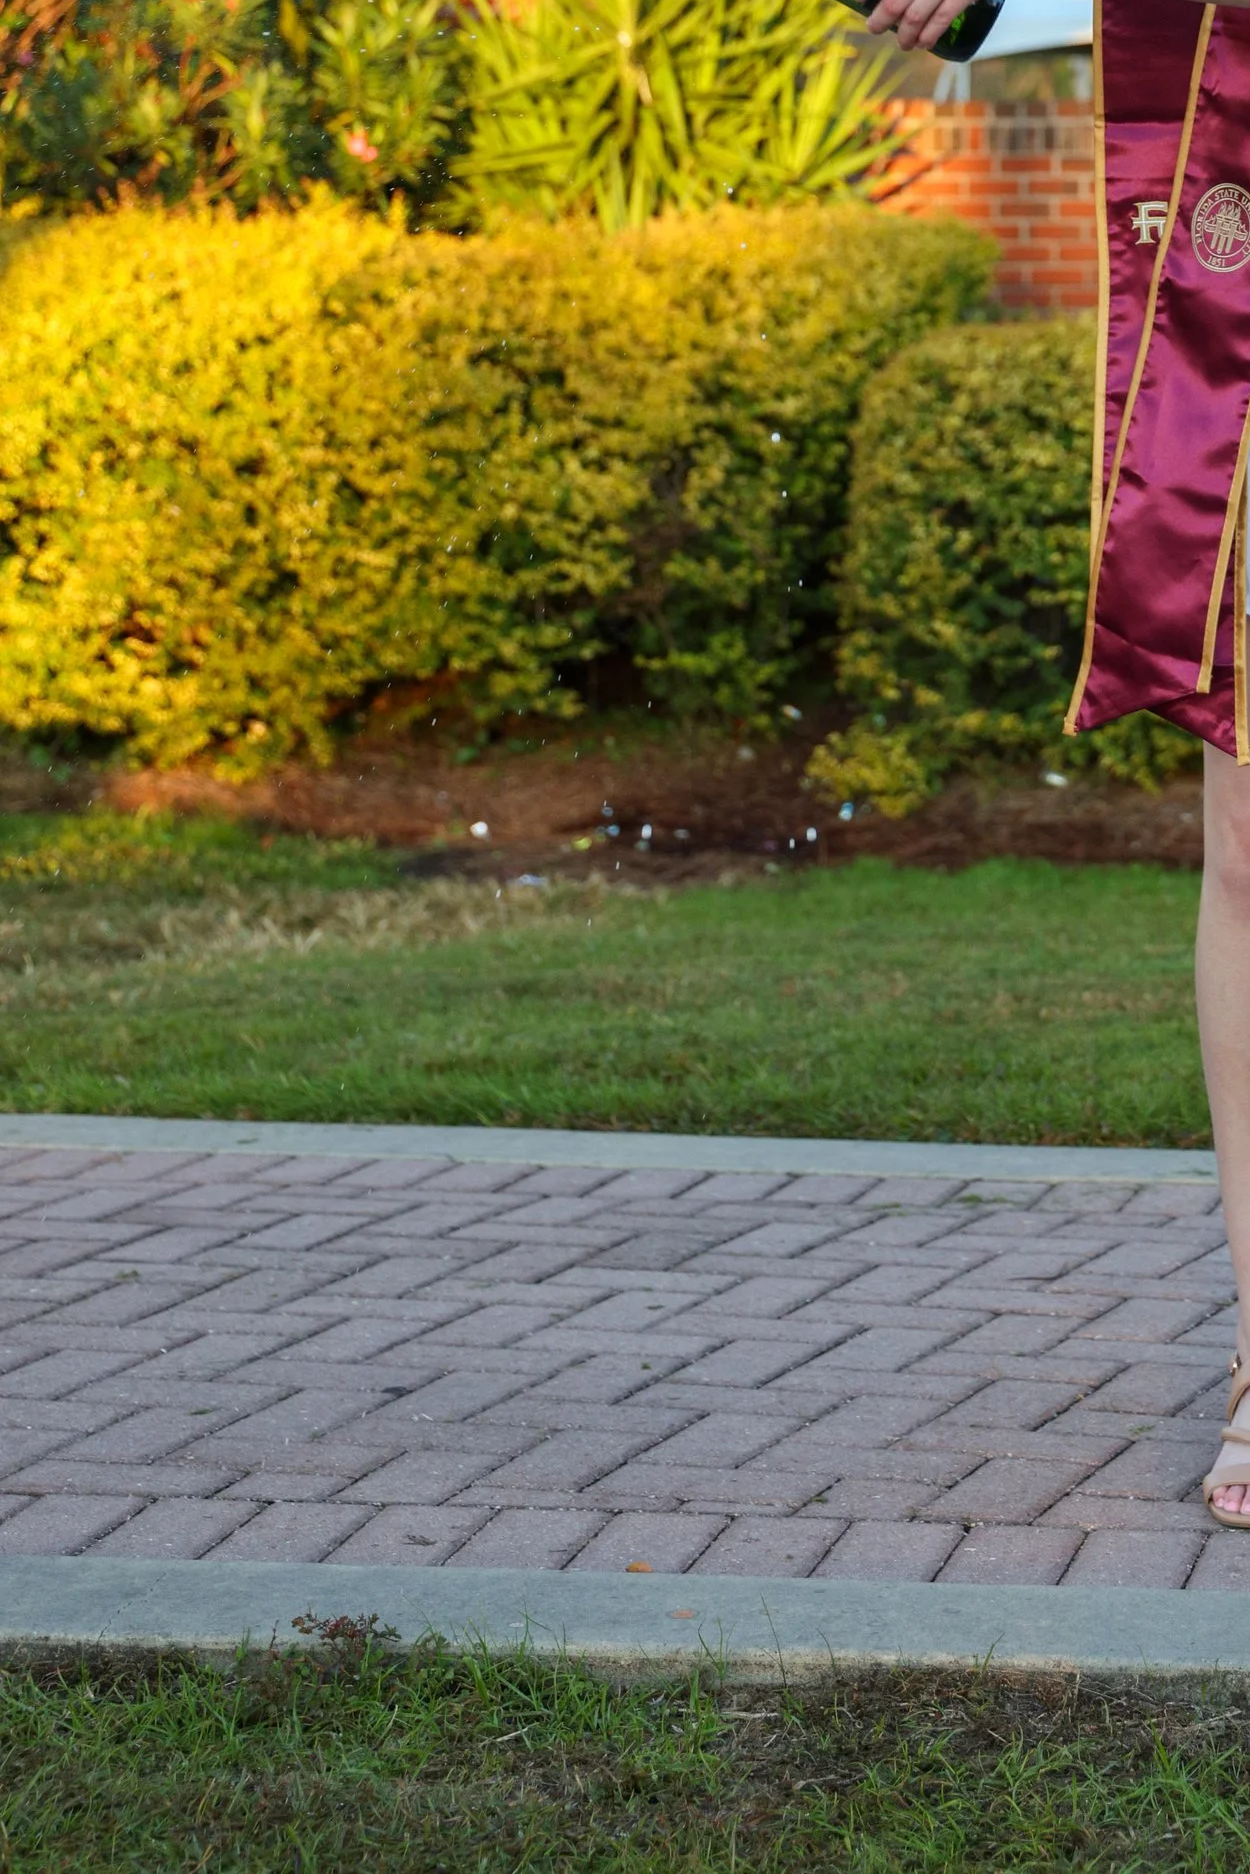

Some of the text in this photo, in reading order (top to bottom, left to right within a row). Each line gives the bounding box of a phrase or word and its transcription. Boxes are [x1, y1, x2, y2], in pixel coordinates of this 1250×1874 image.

[1195, 198, 1214, 244] FLORIDA
[1214, 189, 1240, 201] STATE
[1207, 255, 1226, 267] 1851
